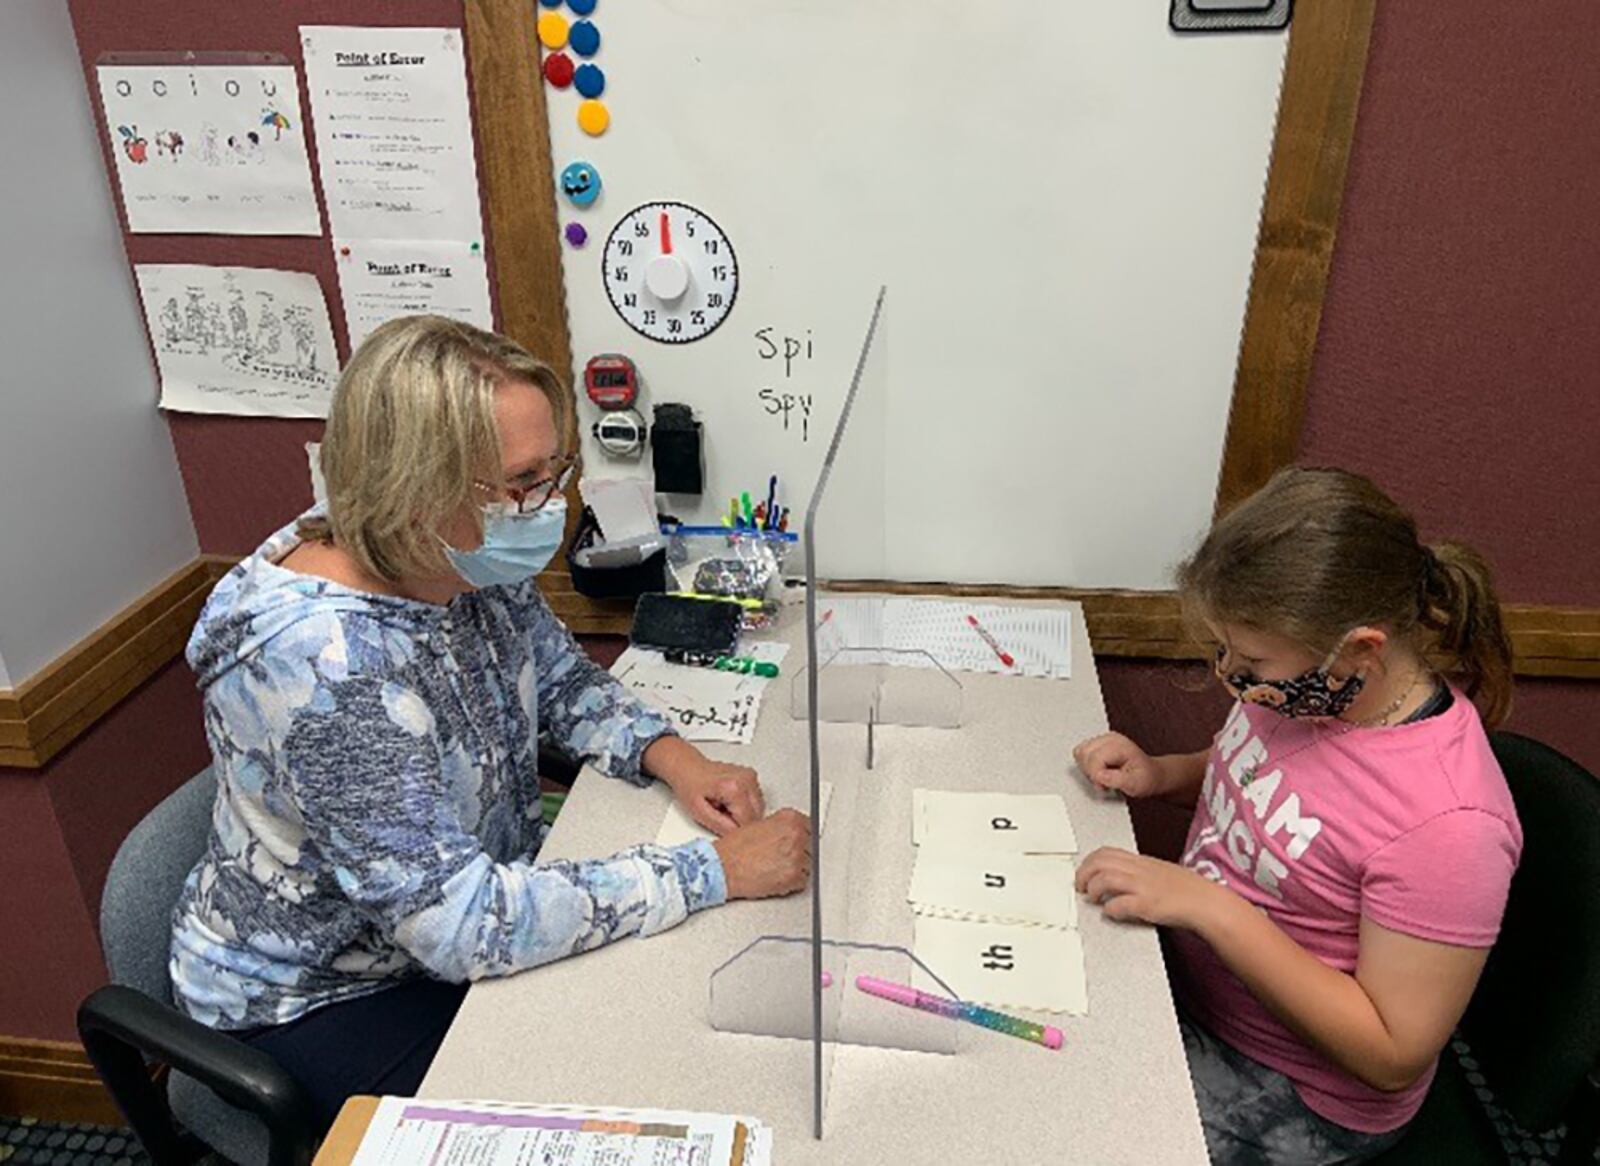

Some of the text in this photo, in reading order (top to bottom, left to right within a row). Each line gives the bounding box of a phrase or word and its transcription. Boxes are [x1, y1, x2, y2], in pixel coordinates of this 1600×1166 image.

[634, 222, 650, 238] 55
[685, 221, 695, 238] 5
[703, 240, 718, 255] 10
[711, 265, 727, 281] 15
[706, 293, 722, 308] 20
[690, 310, 705, 325] 25
[666, 319, 682, 333] 30
[1216, 700, 1322, 860] REAM
[981, 944, 1015, 971] th
